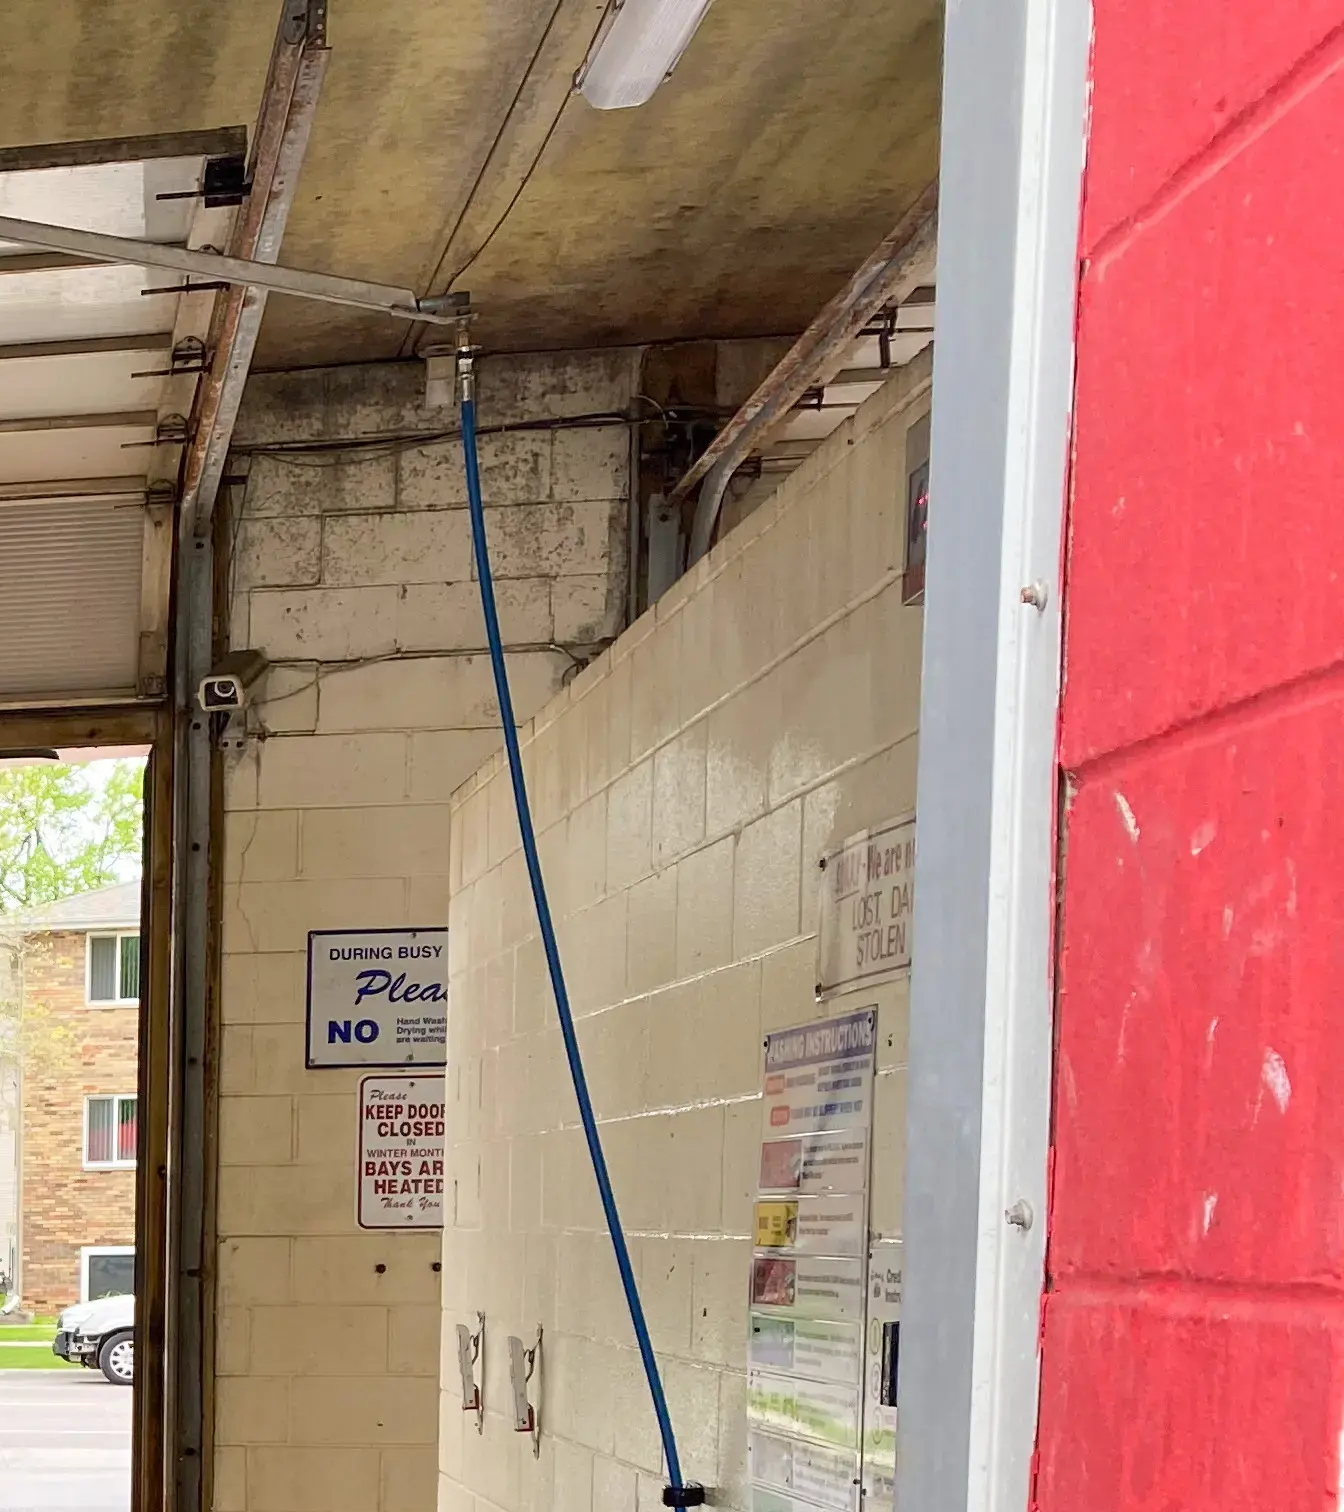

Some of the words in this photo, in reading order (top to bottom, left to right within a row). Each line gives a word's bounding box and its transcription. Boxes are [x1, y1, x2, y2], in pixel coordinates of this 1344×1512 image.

[857, 921, 906, 966] STOLEN
[329, 946, 392, 960] DURING
[398, 946, 442, 959] BUSY
[328, 1019, 380, 1044] NO
[396, 1026, 426, 1036] Drying
[805, 1020, 872, 1058] INSTRUCTIONS
[370, 1090, 408, 1100] Please
[366, 1104, 404, 1120] KEEP
[378, 1122, 444, 1137] CLOSED
[367, 1148, 408, 1158] WINTER
[365, 1161, 412, 1176] BAYS
[374, 1179, 444, 1194] HEATED
[380, 1197, 413, 1208] Thank
[419, 1196, 440, 1211] You
